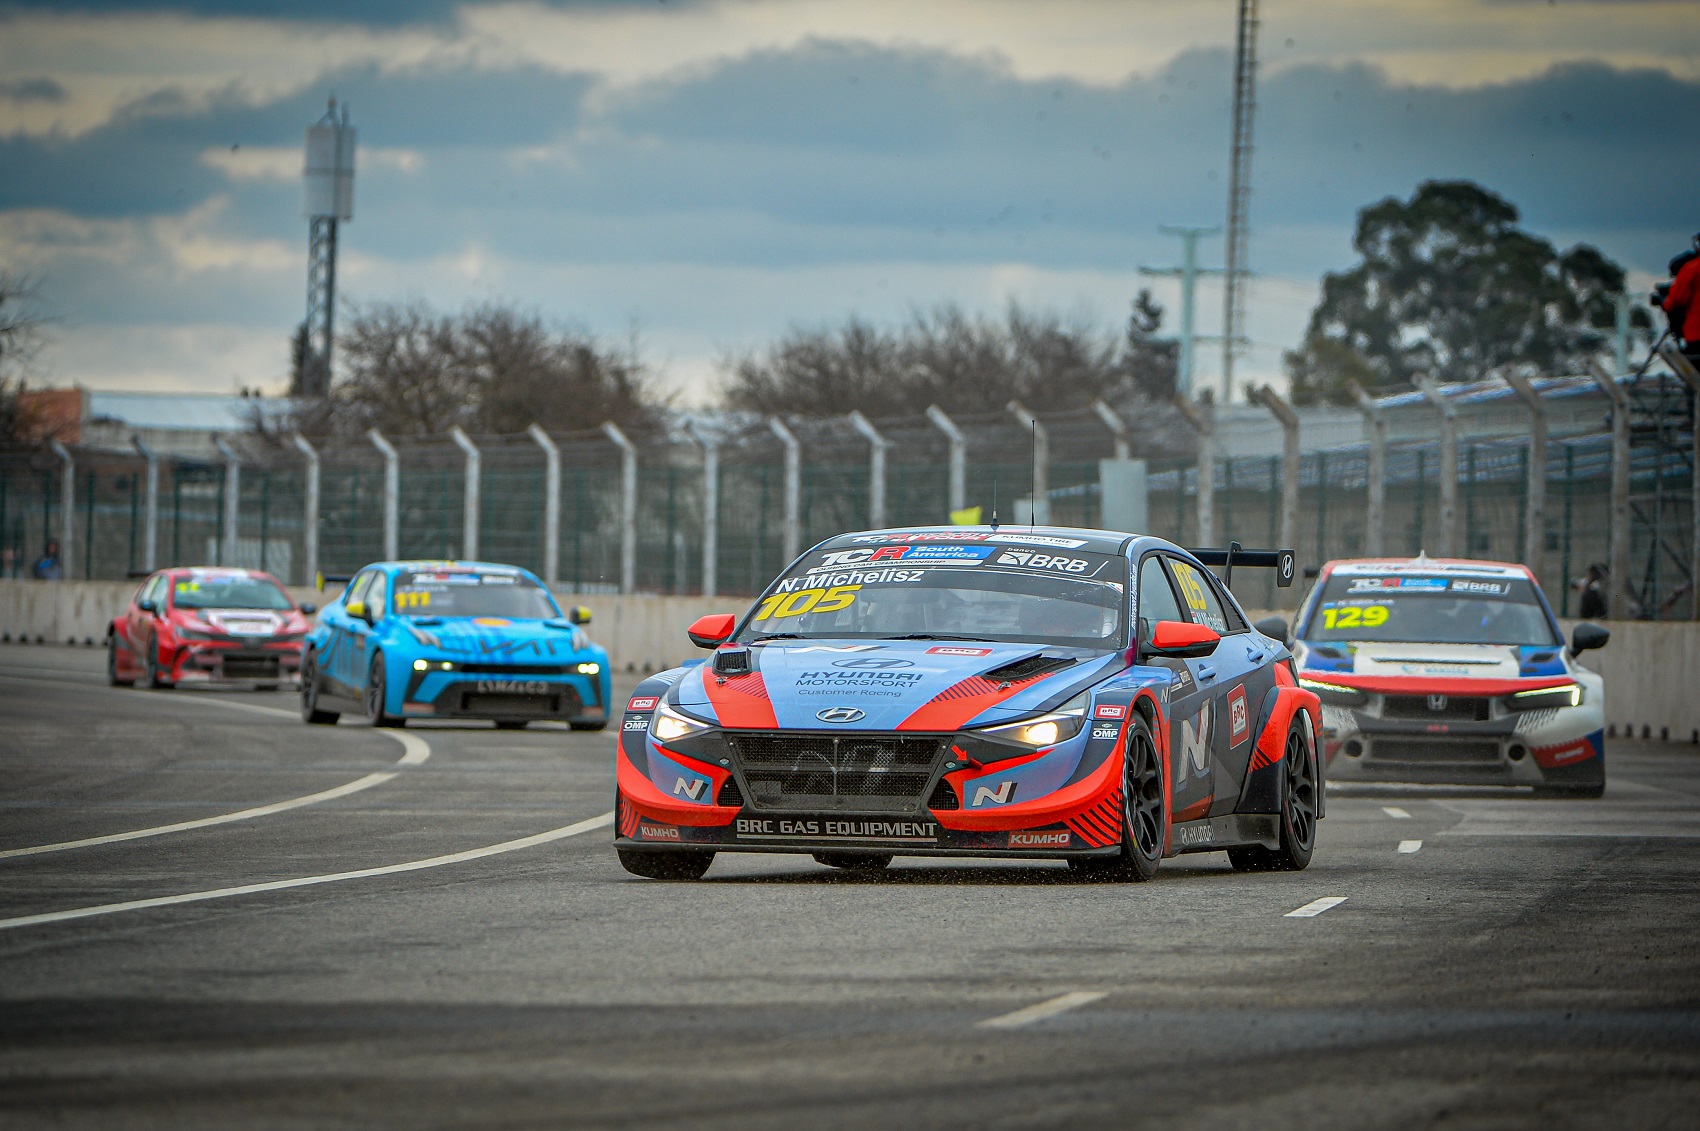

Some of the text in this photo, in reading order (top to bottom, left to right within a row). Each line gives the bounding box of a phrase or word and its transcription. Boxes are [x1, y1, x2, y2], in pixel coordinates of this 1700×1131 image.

[821, 546, 911, 566] TCR
[1027, 554, 1089, 573] BRB
[394, 591, 431, 609] 111
[755, 584, 863, 621] 105
[1323, 605, 1390, 630] 129
[800, 671, 924, 681] HYUNDAI
[795, 680, 918, 688] MOTORSPORT
[860, 690, 902, 698] Racing
[1233, 704, 1246, 725] BRC
[624, 722, 649, 730] OMP
[1093, 730, 1118, 738] OMP
[640, 826, 679, 838] KUMHO
[736, 819, 938, 836] BRC GAS EQUIPMENT
[1010, 833, 1070, 844] KUMHO
